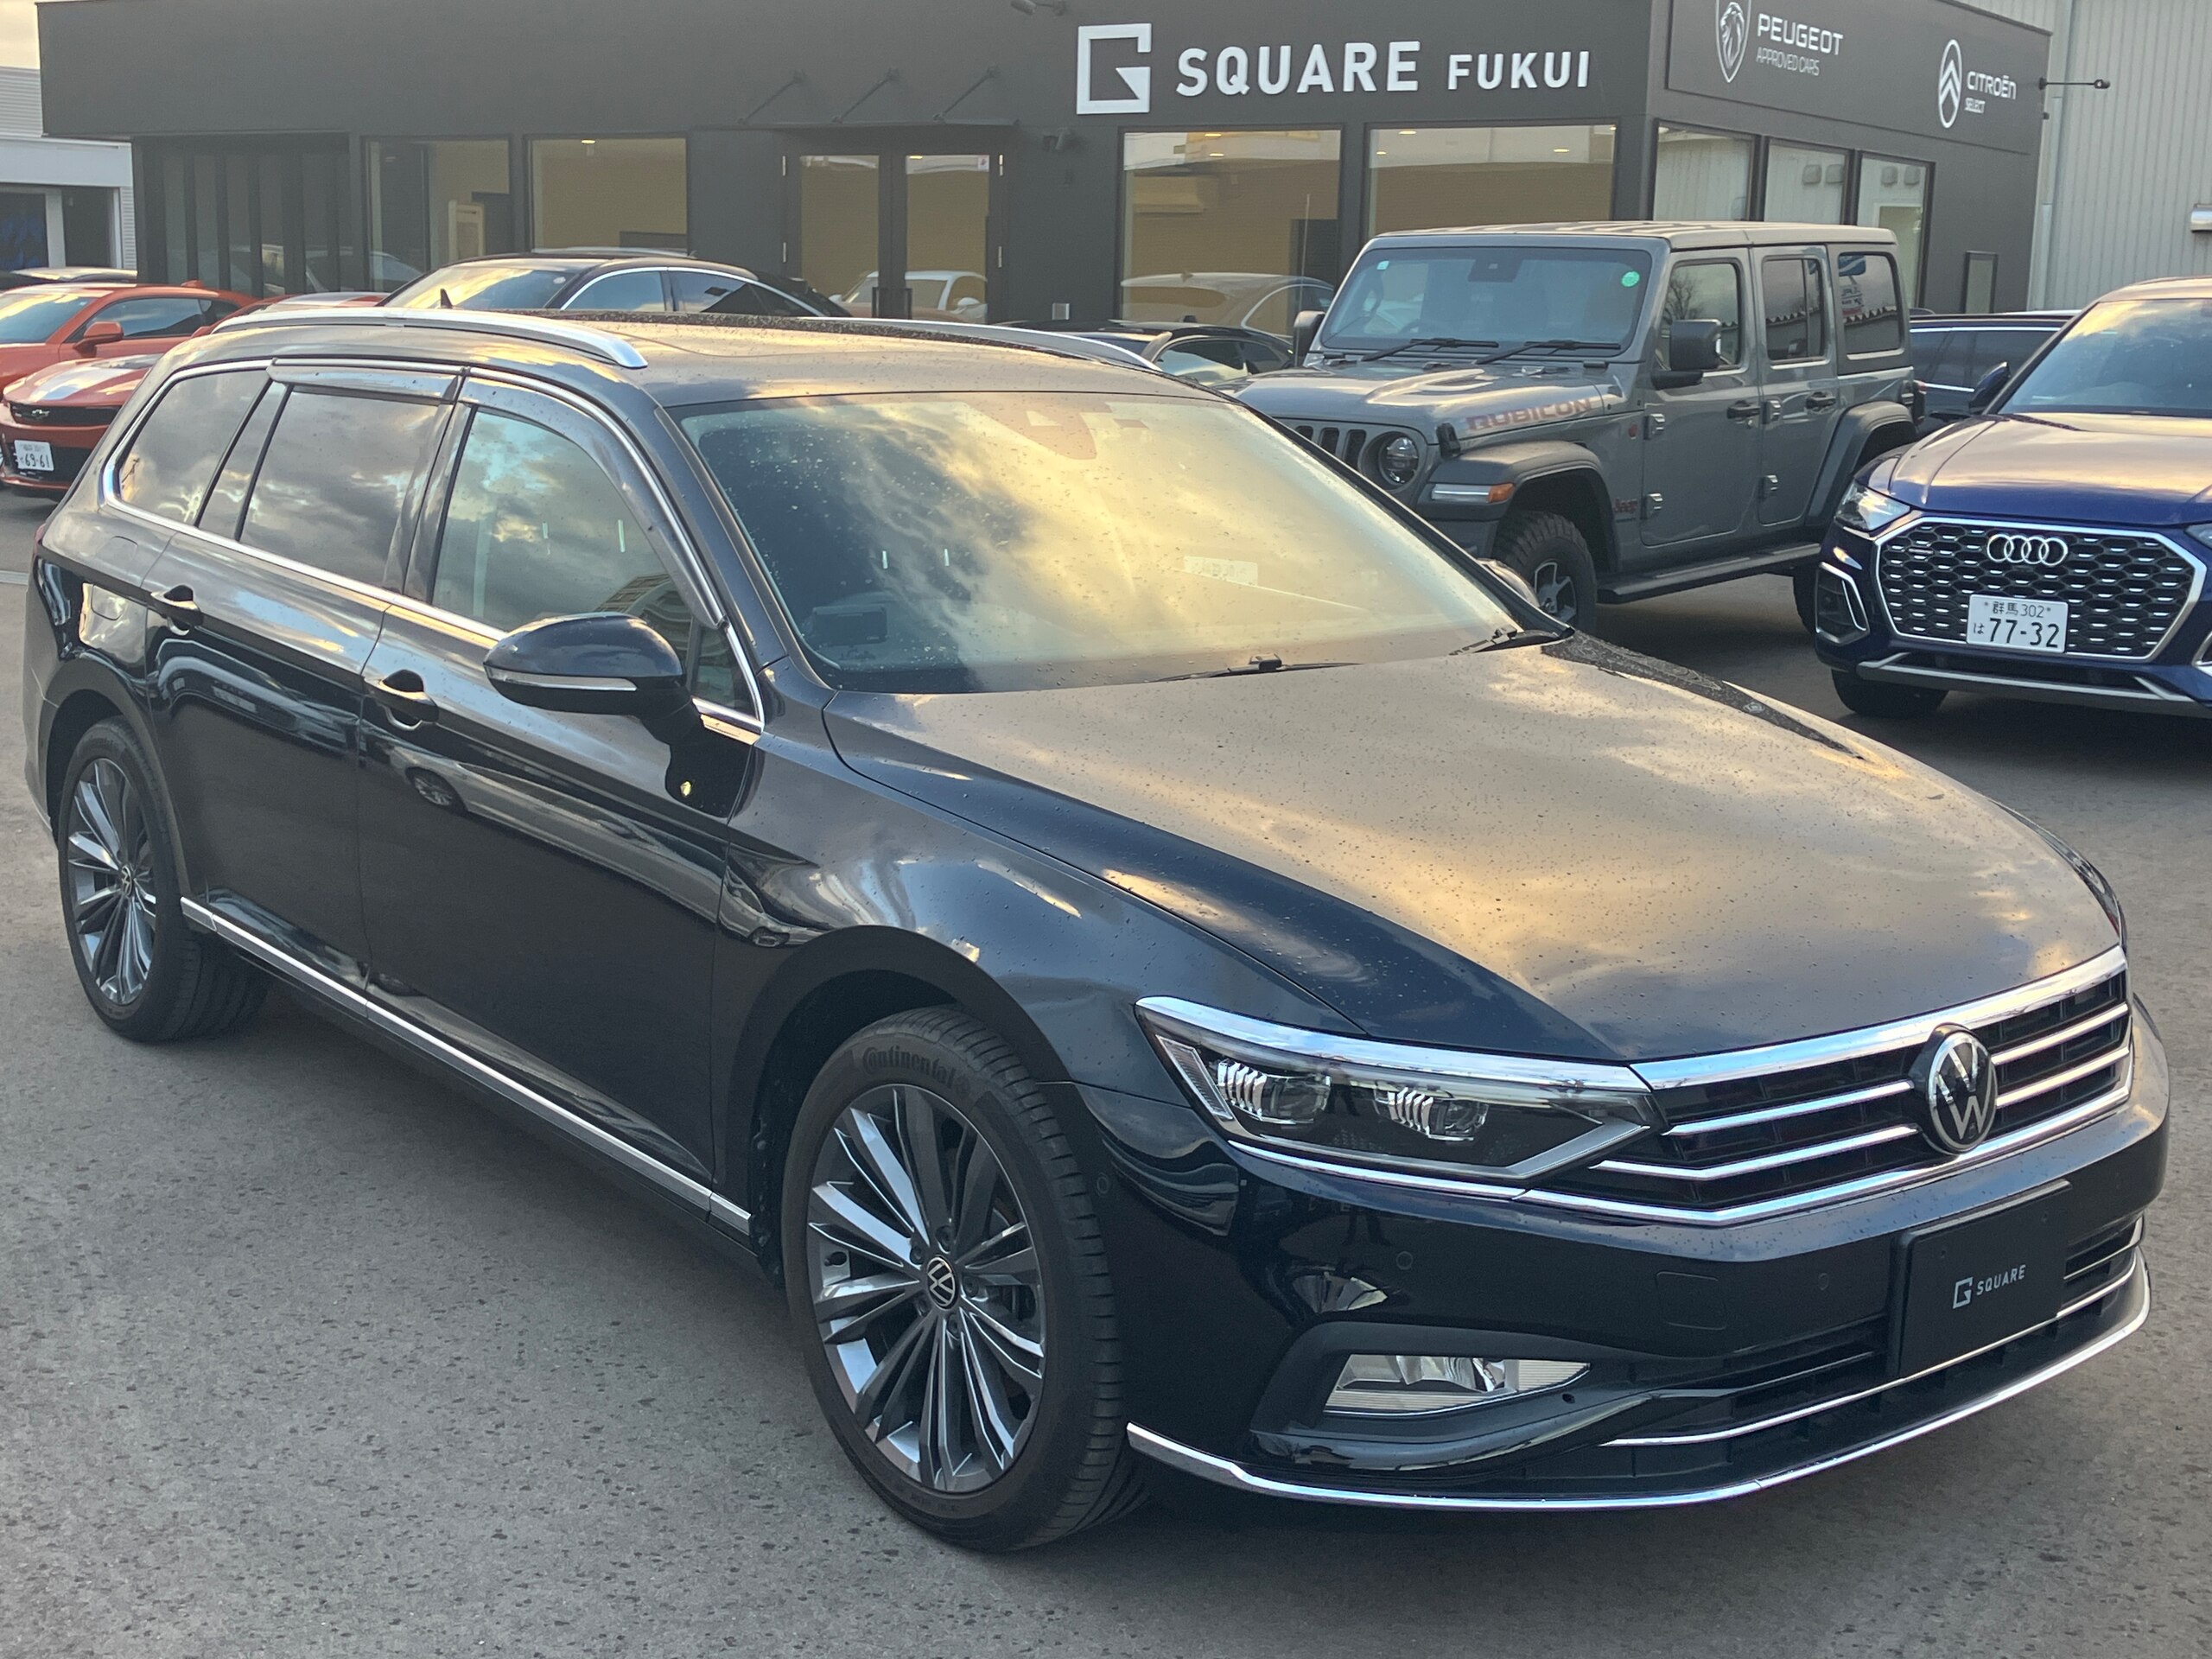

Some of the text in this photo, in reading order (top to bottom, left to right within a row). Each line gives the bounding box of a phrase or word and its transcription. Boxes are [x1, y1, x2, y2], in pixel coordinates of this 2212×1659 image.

[1758, 13, 1843, 55] PEUGEOT
[1175, 41, 1420, 97] SQUARE
[1447, 50, 1589, 90] FUKUI
[1756, 47, 1820, 76] APPROVED CARS
[1465, 398, 1592, 430] RUBICON
[1973, 617, 2060, 649] は 77-32
[862, 1045, 957, 1089] Continental
[1975, 1264, 2026, 1296] SQUARE
